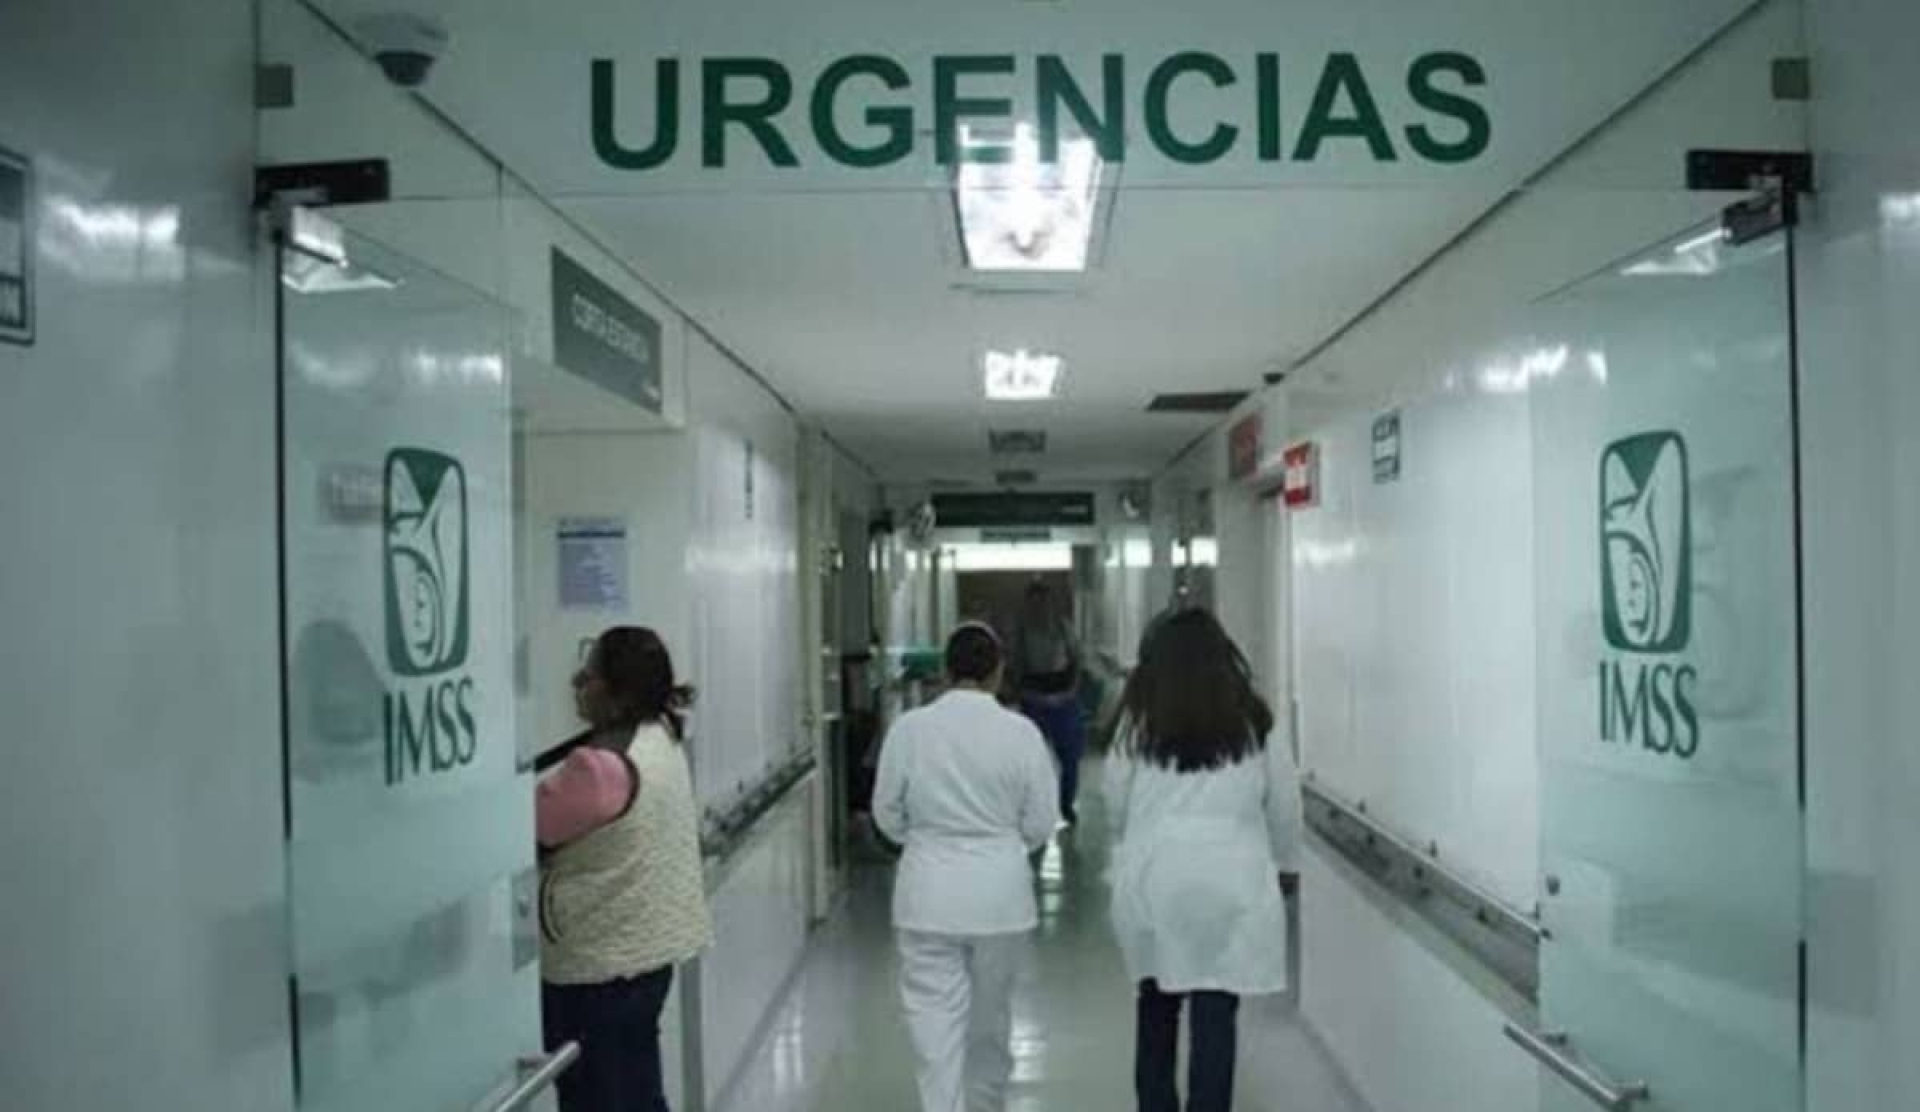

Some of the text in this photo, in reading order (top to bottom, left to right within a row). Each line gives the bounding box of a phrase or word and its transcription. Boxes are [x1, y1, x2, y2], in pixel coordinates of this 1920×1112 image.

[590, 50, 1492, 170] URGENCIAS
[383, 677, 476, 786] IMSS
[1599, 661, 1699, 759] IMSS
